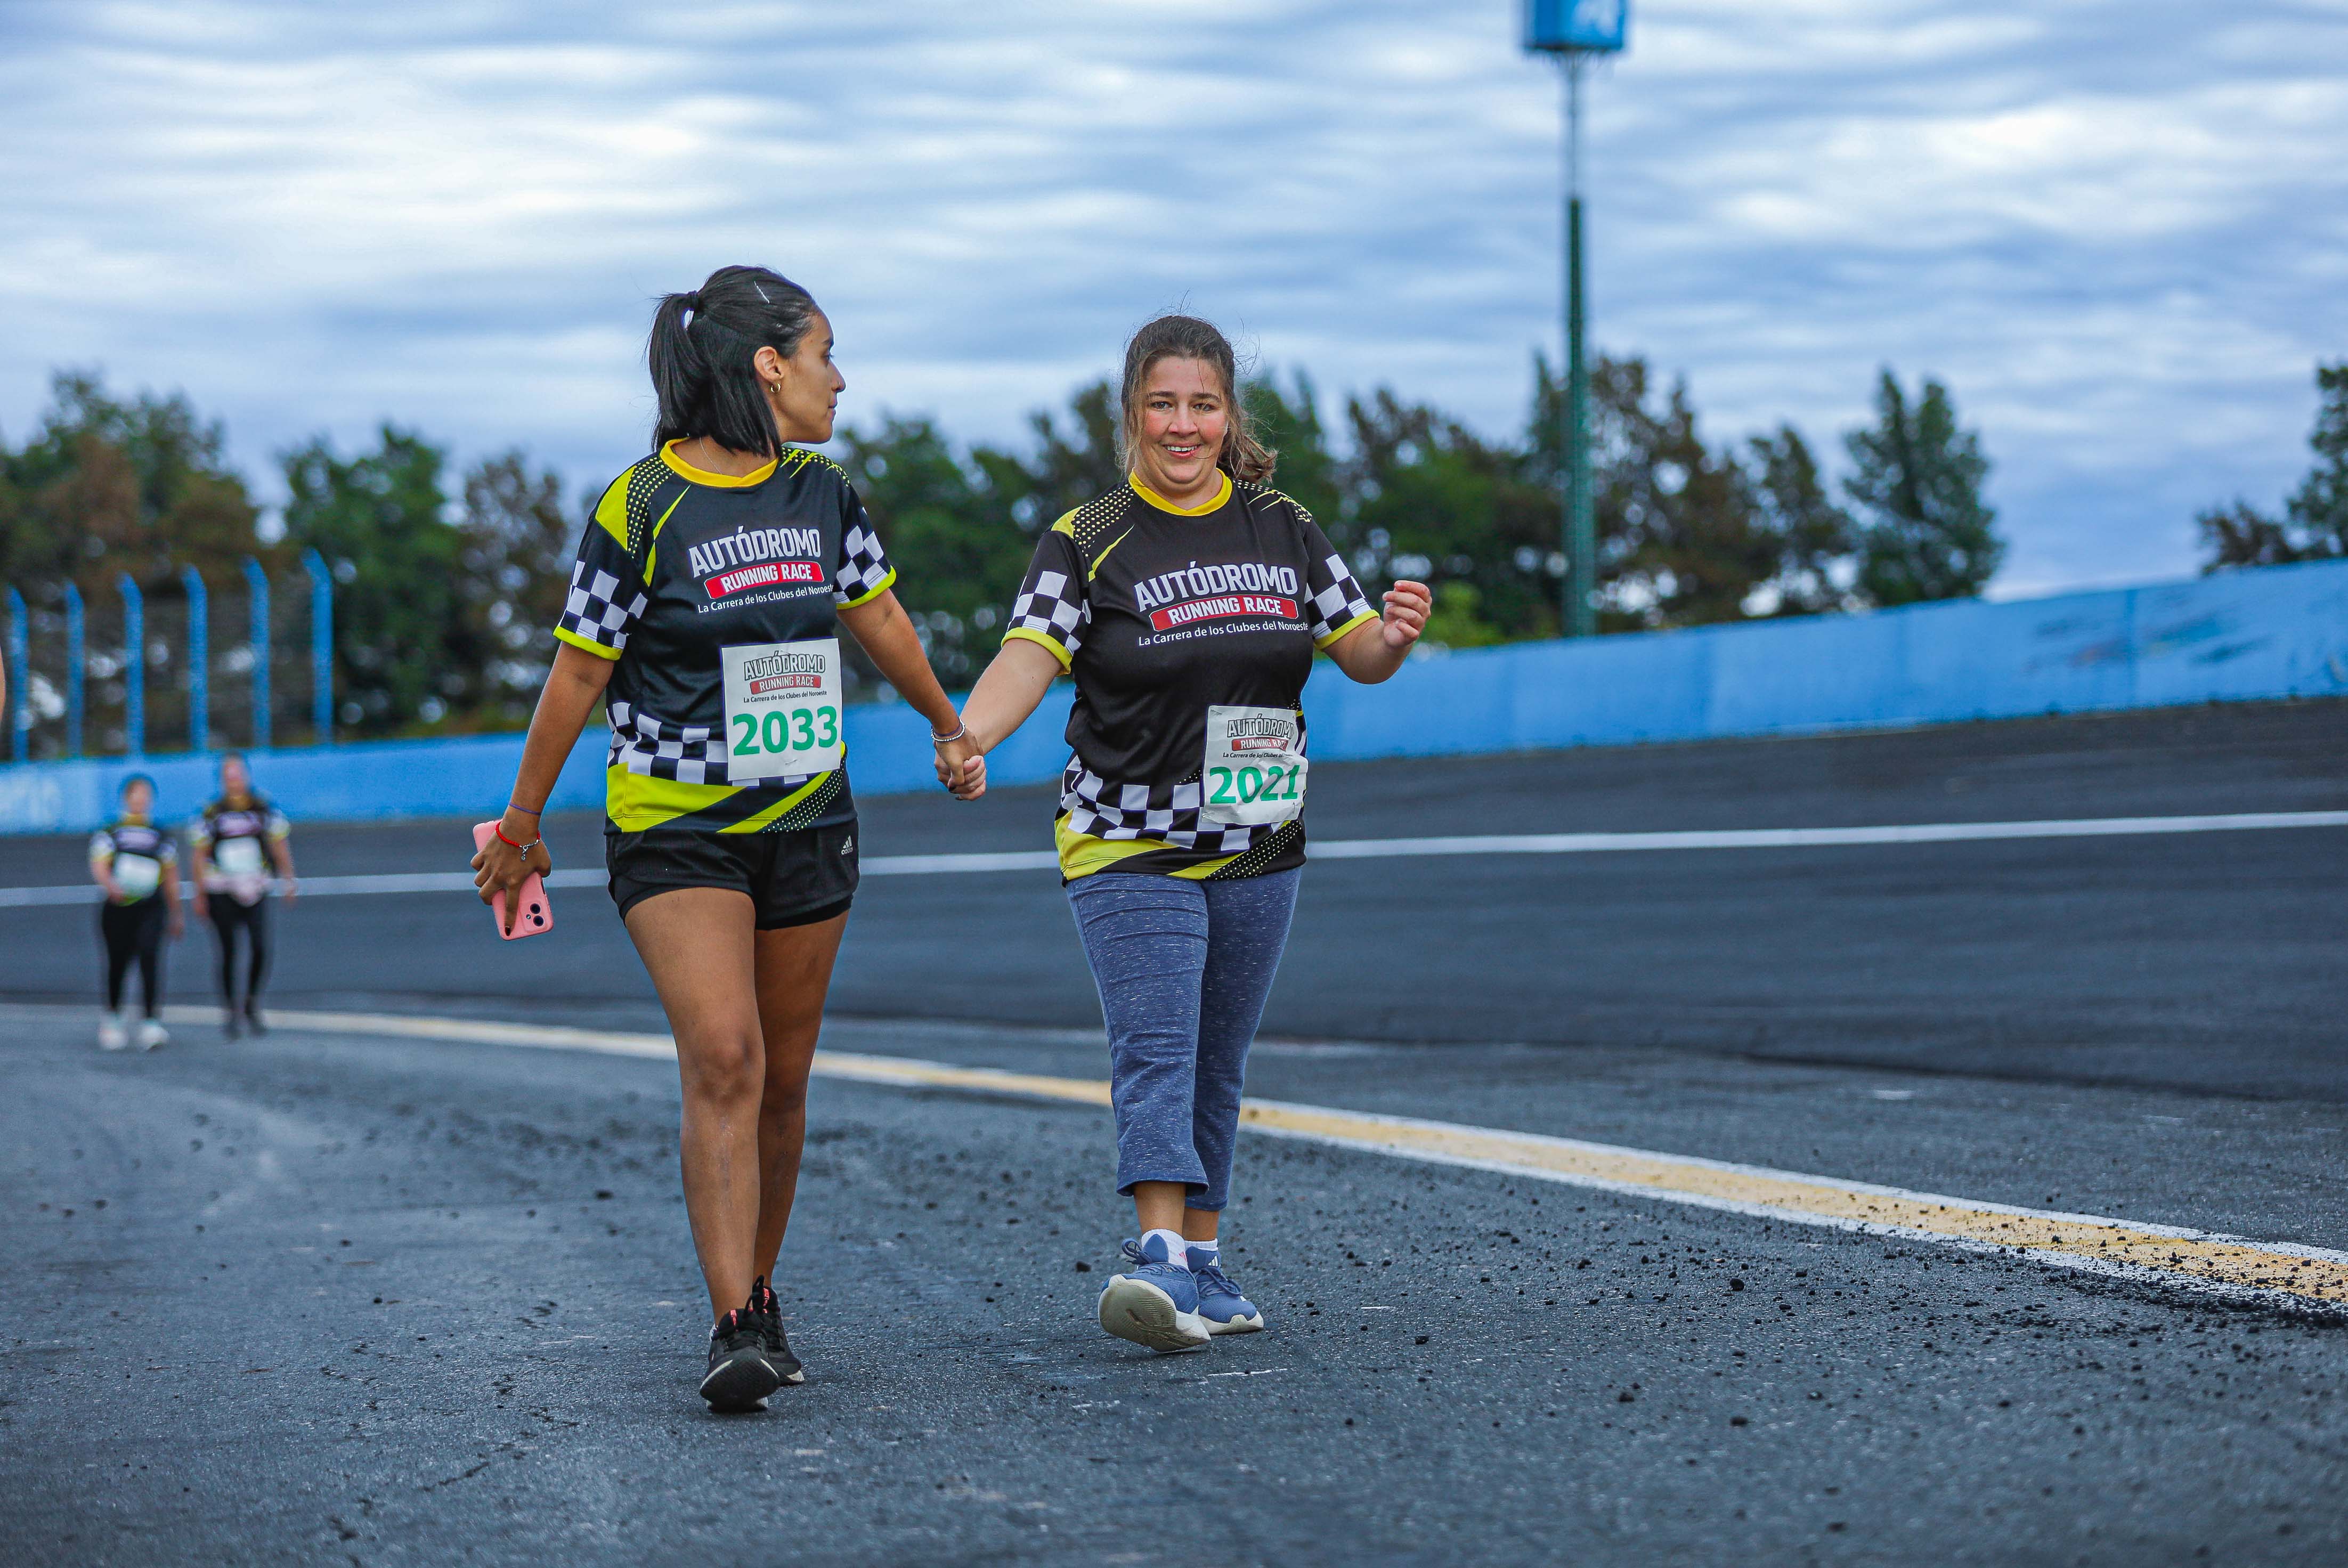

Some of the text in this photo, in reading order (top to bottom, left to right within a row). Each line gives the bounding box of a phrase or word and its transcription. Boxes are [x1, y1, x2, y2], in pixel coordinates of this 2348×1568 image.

[688, 525, 822, 578] AUTÓDROMO
[720, 563, 813, 593] RUNNING RACE
[1133, 560, 1298, 612] AUTÓDROMO
[697, 604, 709, 613] La
[710, 598, 744, 611] Carrera
[745, 595, 755, 605] de
[755, 593, 767, 603] los
[768, 590, 794, 601] Clubes
[795, 587, 808, 597] del
[1167, 597, 1283, 625] RUNNING RACE
[1139, 620, 1309, 646] La Carrera de los Clubes del Noroeste
[744, 651, 826, 681] AUTÓDROMO
[759, 675, 814, 692] RUNNING RACE
[732, 705, 838, 756] 2033
[1240, 738, 1271, 750] RUNNING
[1209, 765, 1300, 804] 2021
